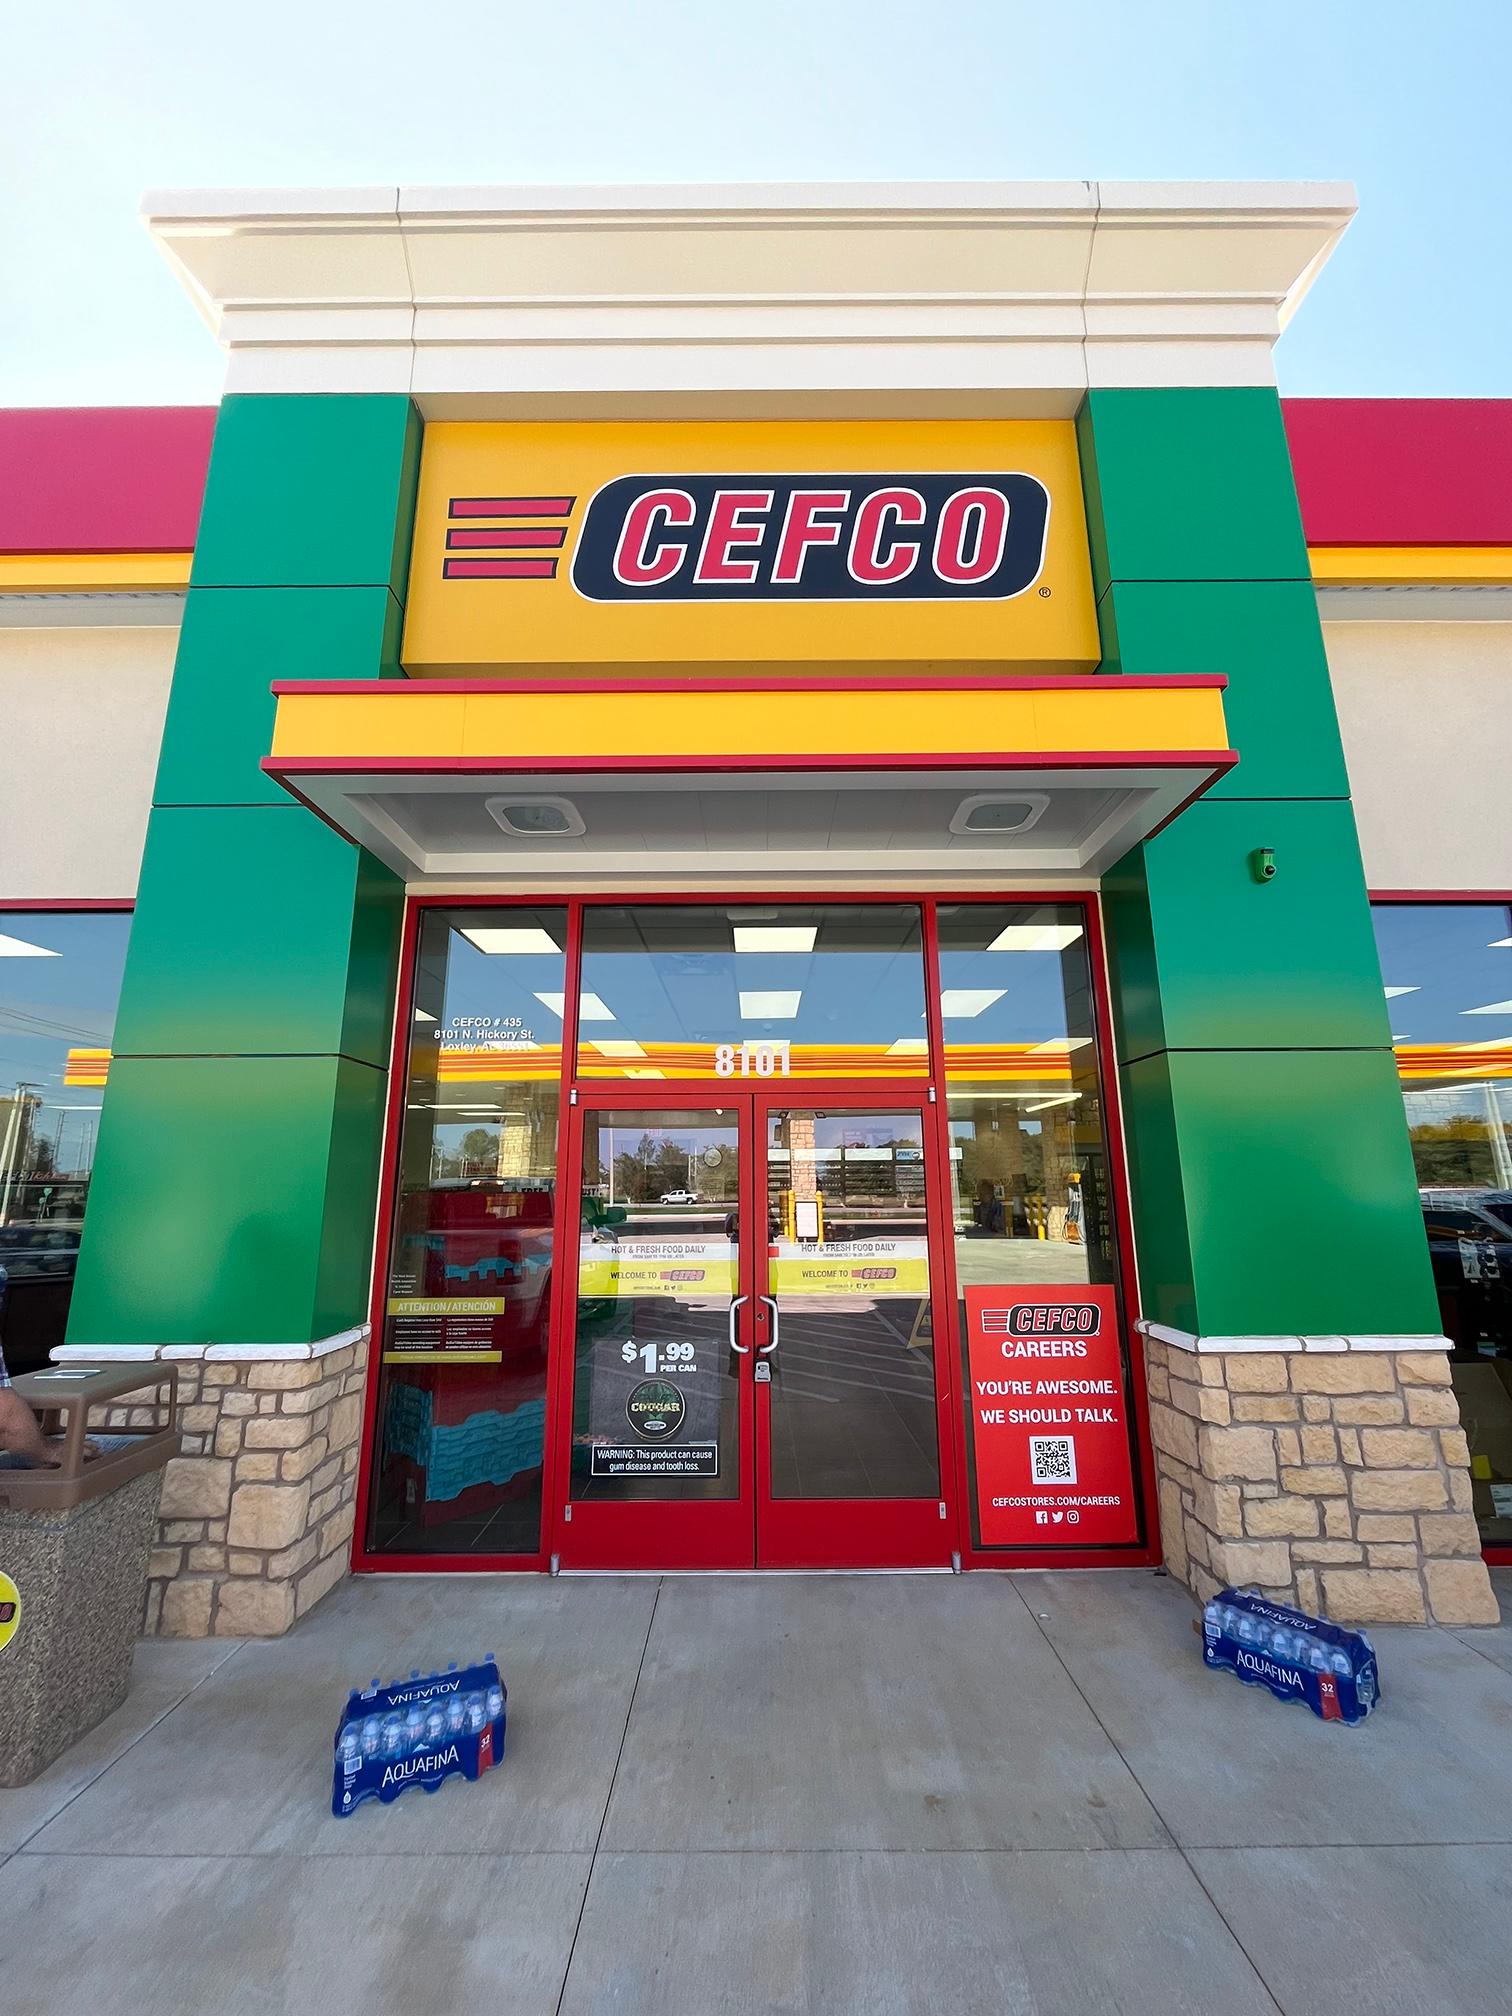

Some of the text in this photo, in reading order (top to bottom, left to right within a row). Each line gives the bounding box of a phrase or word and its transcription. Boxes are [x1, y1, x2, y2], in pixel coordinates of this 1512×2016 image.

[612, 486, 1010, 586] CEFCO
[452, 1017, 522, 1027] CEFCO # 435
[434, 1029, 535, 1040] 8101 N. Hickory St.
[714, 1044, 791, 1077] 8101
[611, 1245, 627, 1254] HOT
[636, 1245, 660, 1254] FRESH
[662, 1245, 683, 1253] FOOD
[685, 1245, 706, 1253] DAILY
[801, 1243, 896, 1252] HOT & FRESH FOOD DAILY
[610, 1270, 704, 1280] WELCOME TO CEFCO
[802, 1268, 896, 1279] WELCOME TO CEFCO
[1016, 1307, 1093, 1331] CEFCO
[1001, 1340, 1088, 1358] CAREERS
[621, 1340, 695, 1374] $1.99
[660, 1364, 697, 1372] PER CAN
[976, 1380, 1118, 1396] YOU'RE AWESOME.
[630, 1402, 681, 1413] COUGAR
[980, 1408, 1118, 1424] WE SHOULD TALK.
[597, 1449, 713, 1461] WARNING: This product can cause
[609, 1461, 700, 1472] gum disease and tooth loss.
[992, 1496, 1121, 1507] CEFCOSTORES.COM/CAREERS
[1250, 1602, 1317, 1631] AQUAFINA
[1236, 1649, 1304, 1691] AQUAFINA
[387, 1679, 460, 1706] AQUAFINA
[1321, 1682, 1334, 1693] 32
[480, 1734, 491, 1749] 32
[381, 1745, 460, 1788] AQUAFINA
